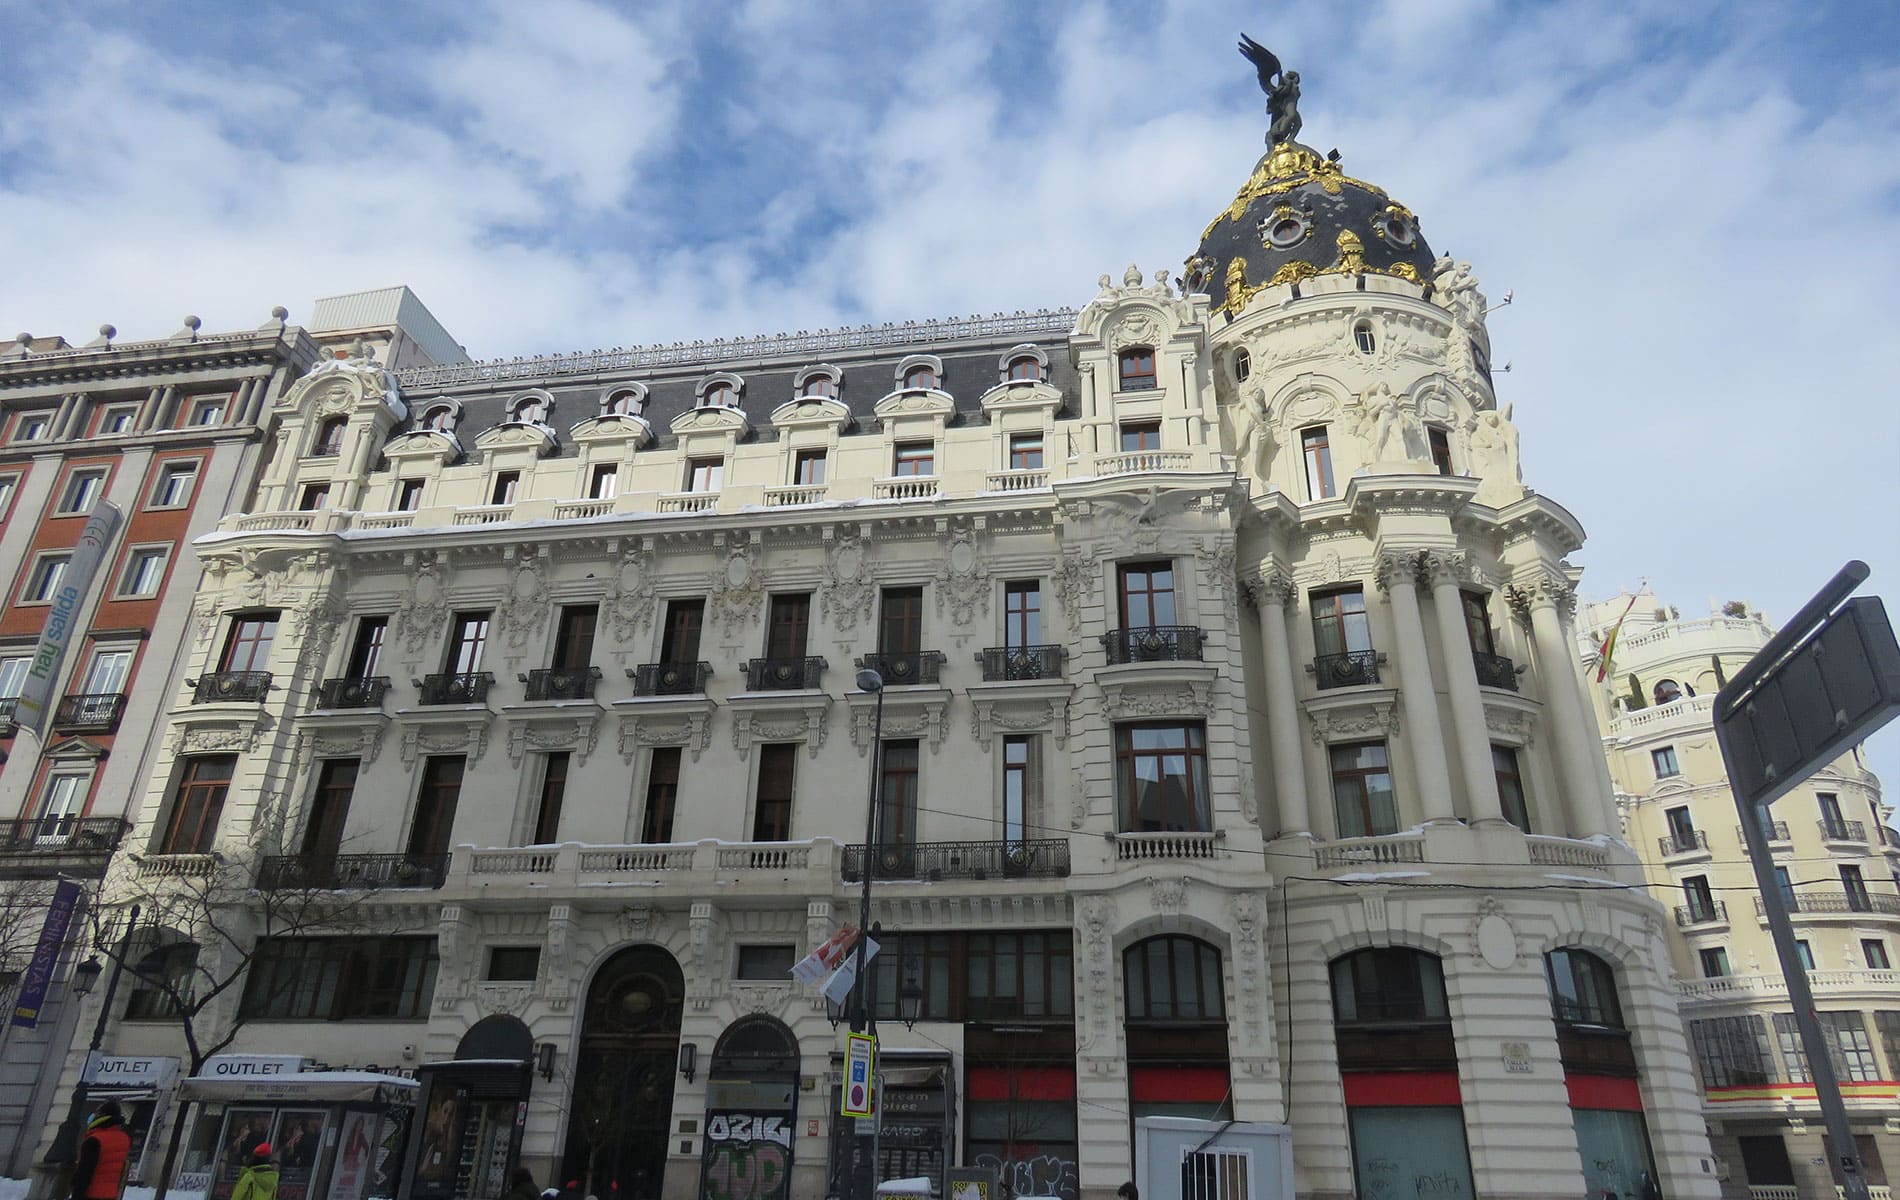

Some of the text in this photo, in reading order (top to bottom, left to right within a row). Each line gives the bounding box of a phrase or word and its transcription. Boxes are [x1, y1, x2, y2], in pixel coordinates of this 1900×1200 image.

[31, 643, 61, 679] hay
[48, 587, 78, 640] salida
[217, 1063, 283, 1075] OUTLET
